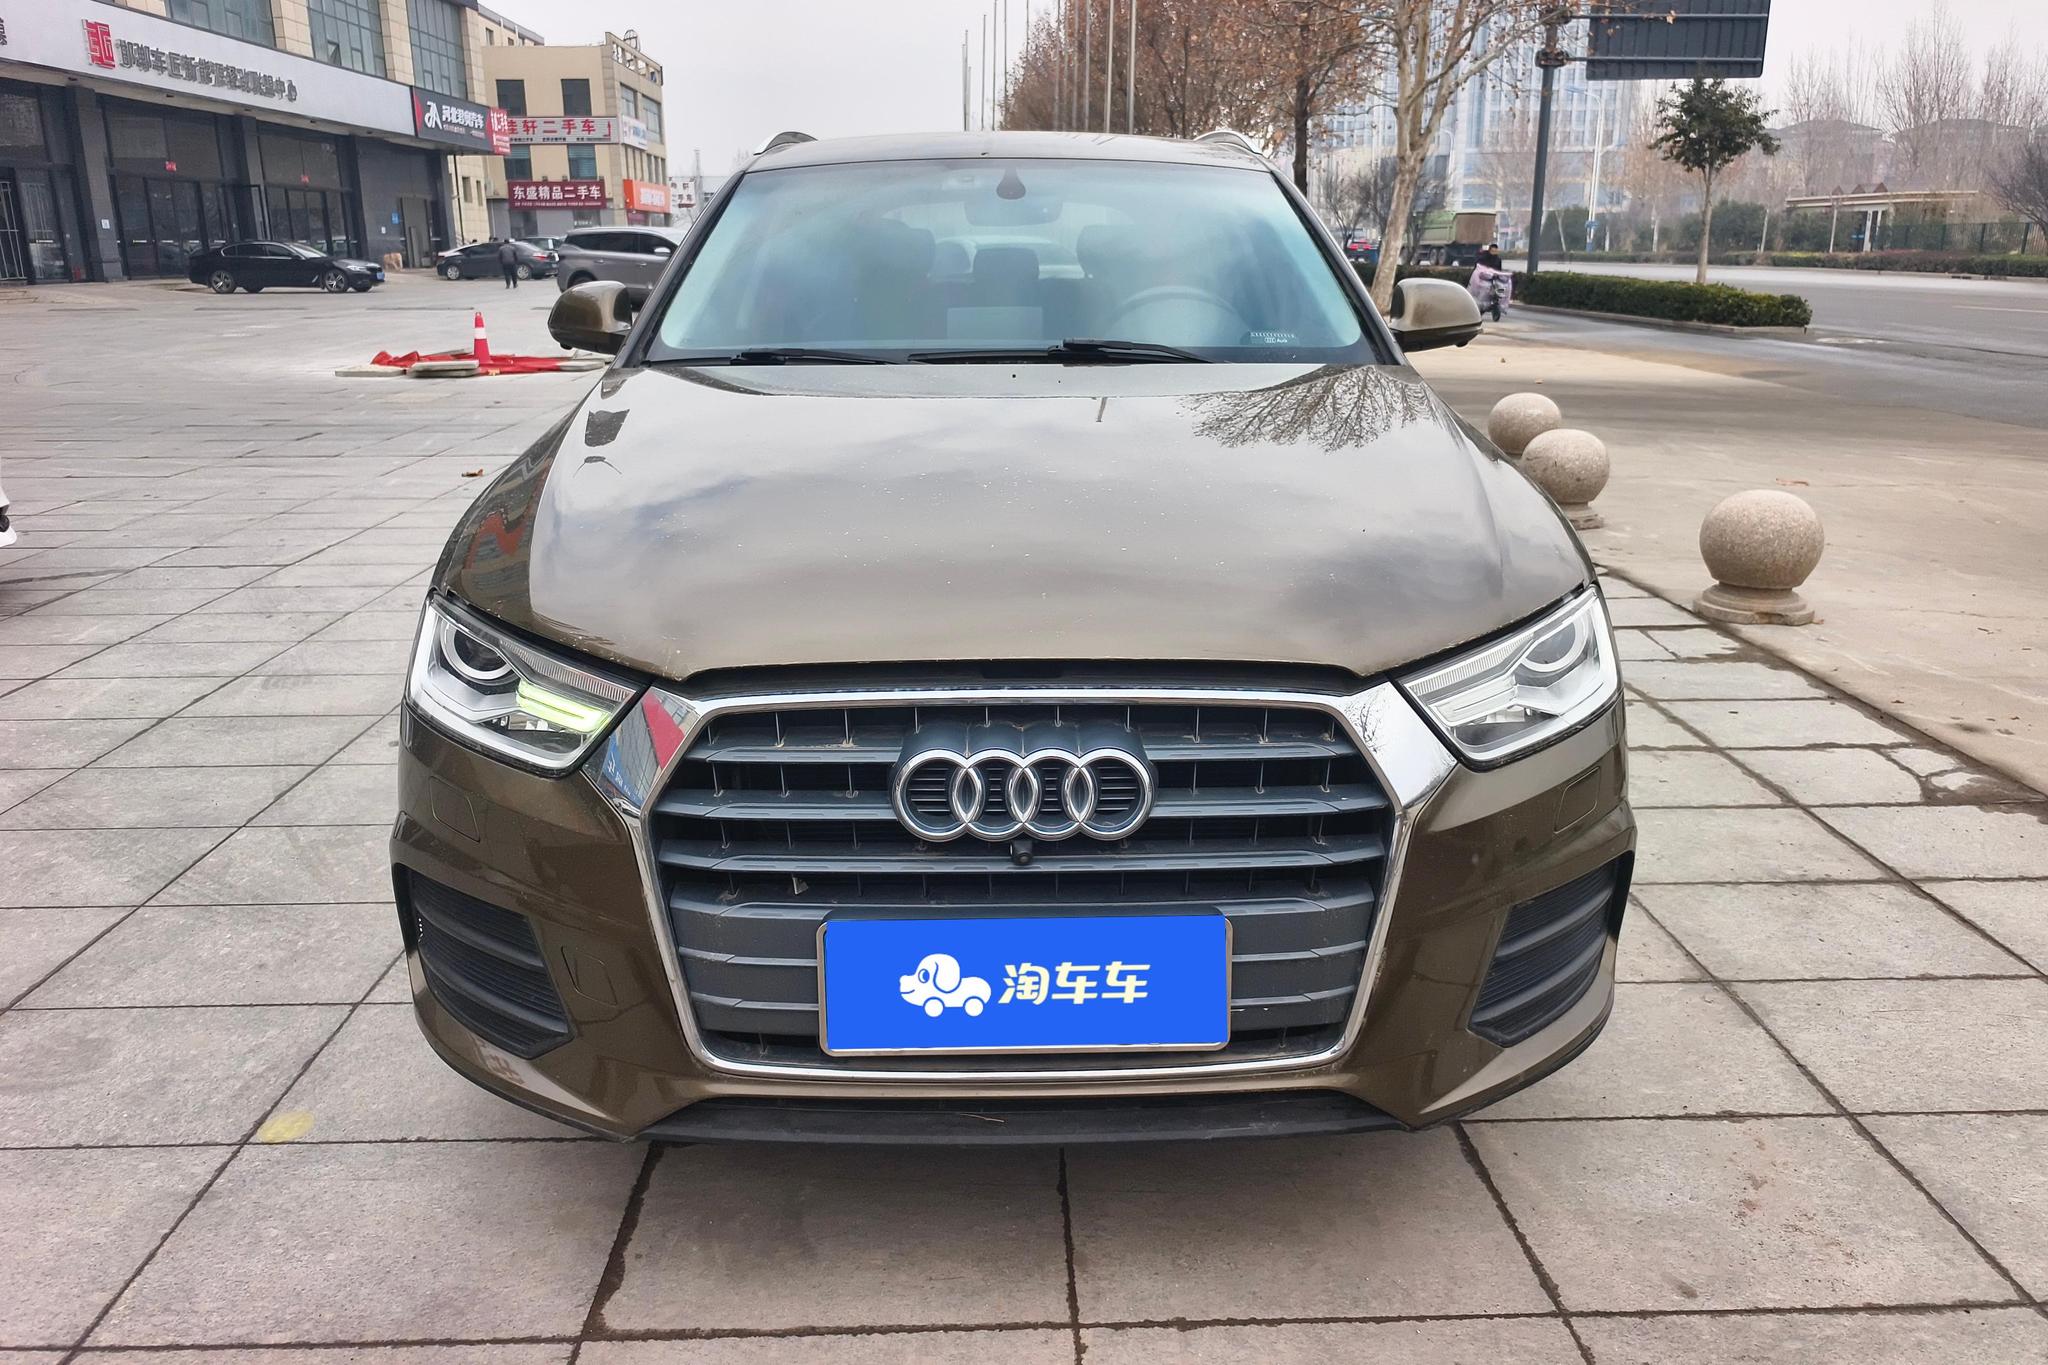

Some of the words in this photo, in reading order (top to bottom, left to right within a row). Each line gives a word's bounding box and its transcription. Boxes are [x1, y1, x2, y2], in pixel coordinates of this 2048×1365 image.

[513, 185, 601, 200] 东盛精品二手车
